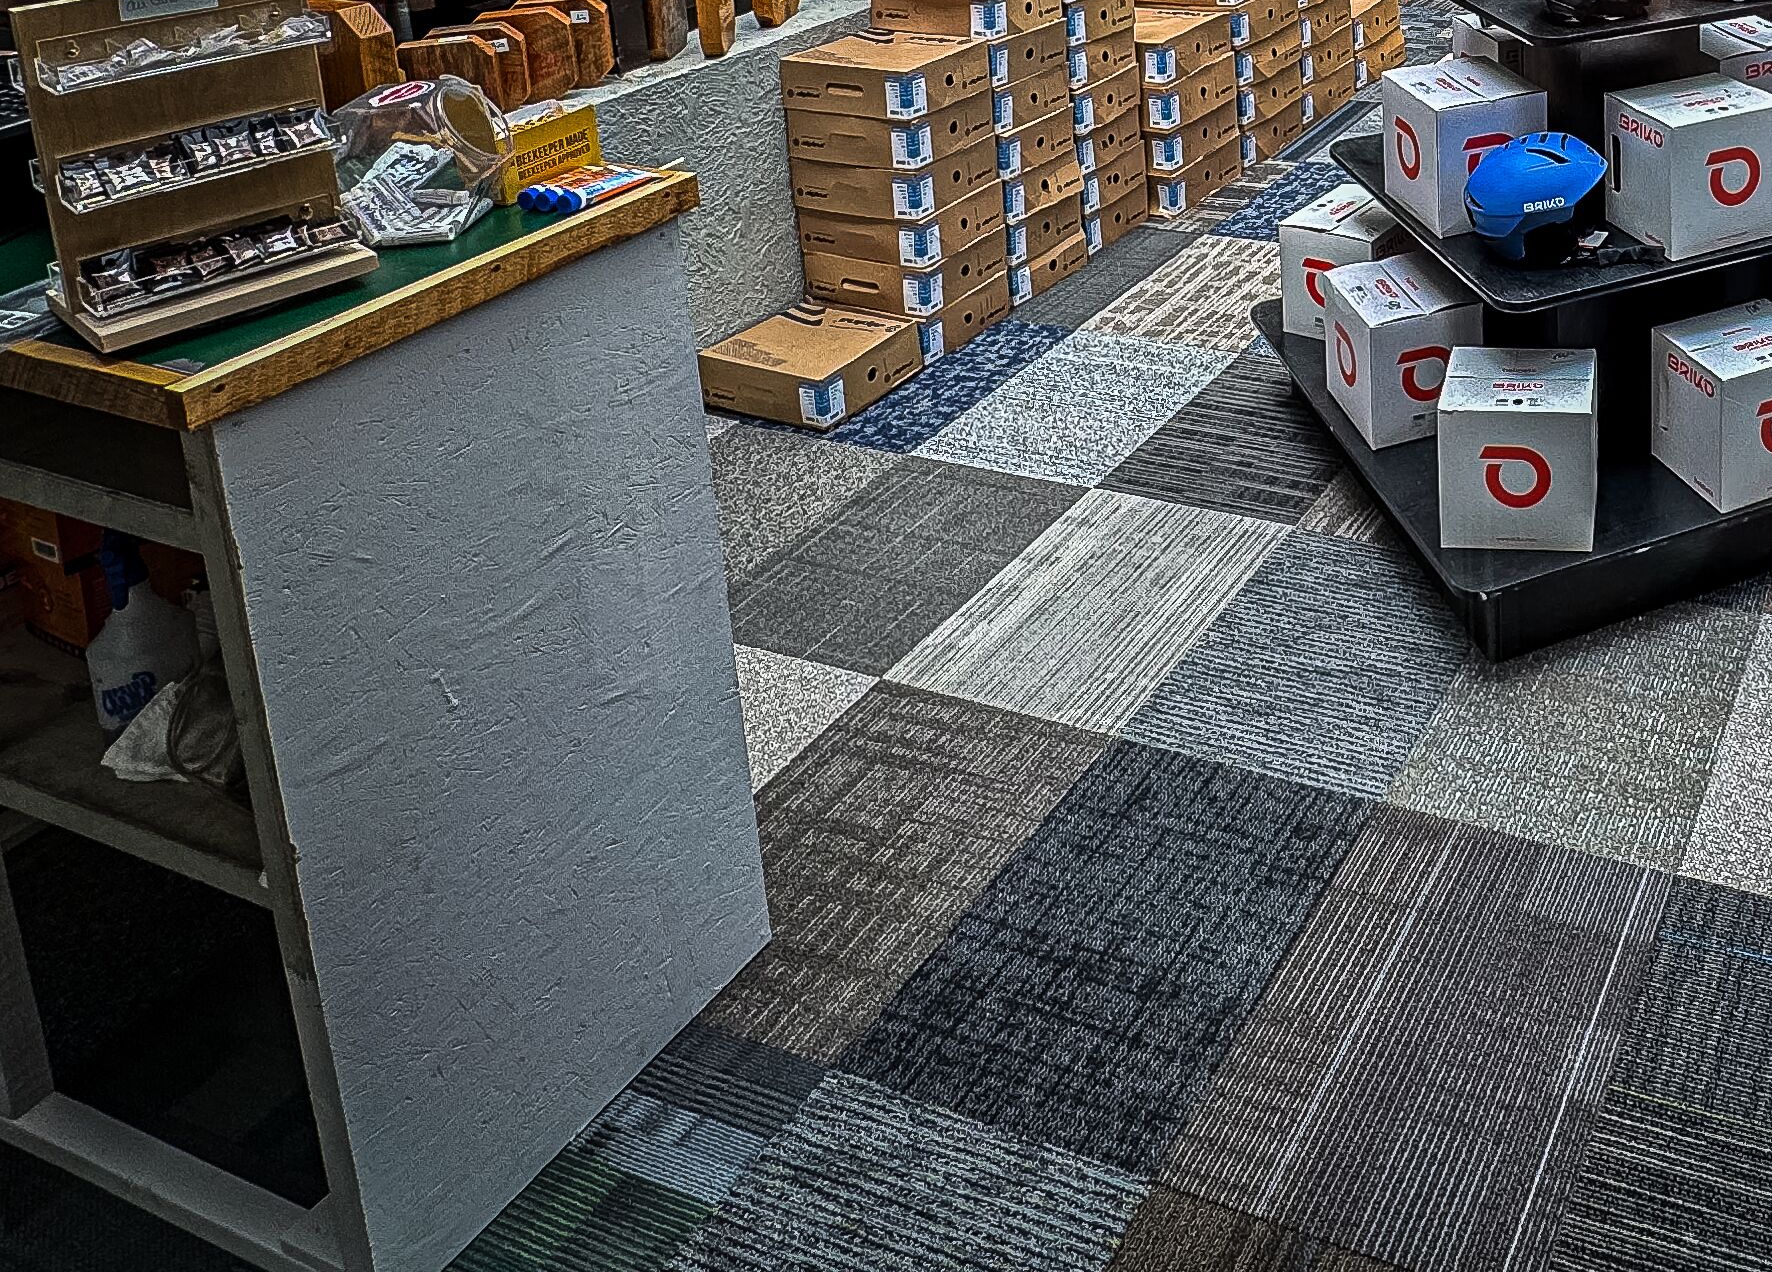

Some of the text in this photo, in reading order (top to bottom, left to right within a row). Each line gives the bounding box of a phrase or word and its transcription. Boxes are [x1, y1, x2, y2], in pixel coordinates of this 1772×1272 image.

[515, 128, 590, 167] BEEKEEPER MADE
[1618, 112, 1665, 149] BRIKO
[517, 143, 591, 181] BEEKEEPER APPROVED
[1523, 197, 1566, 213] BRIKO
[1667, 353, 1716, 398] BRIKO
